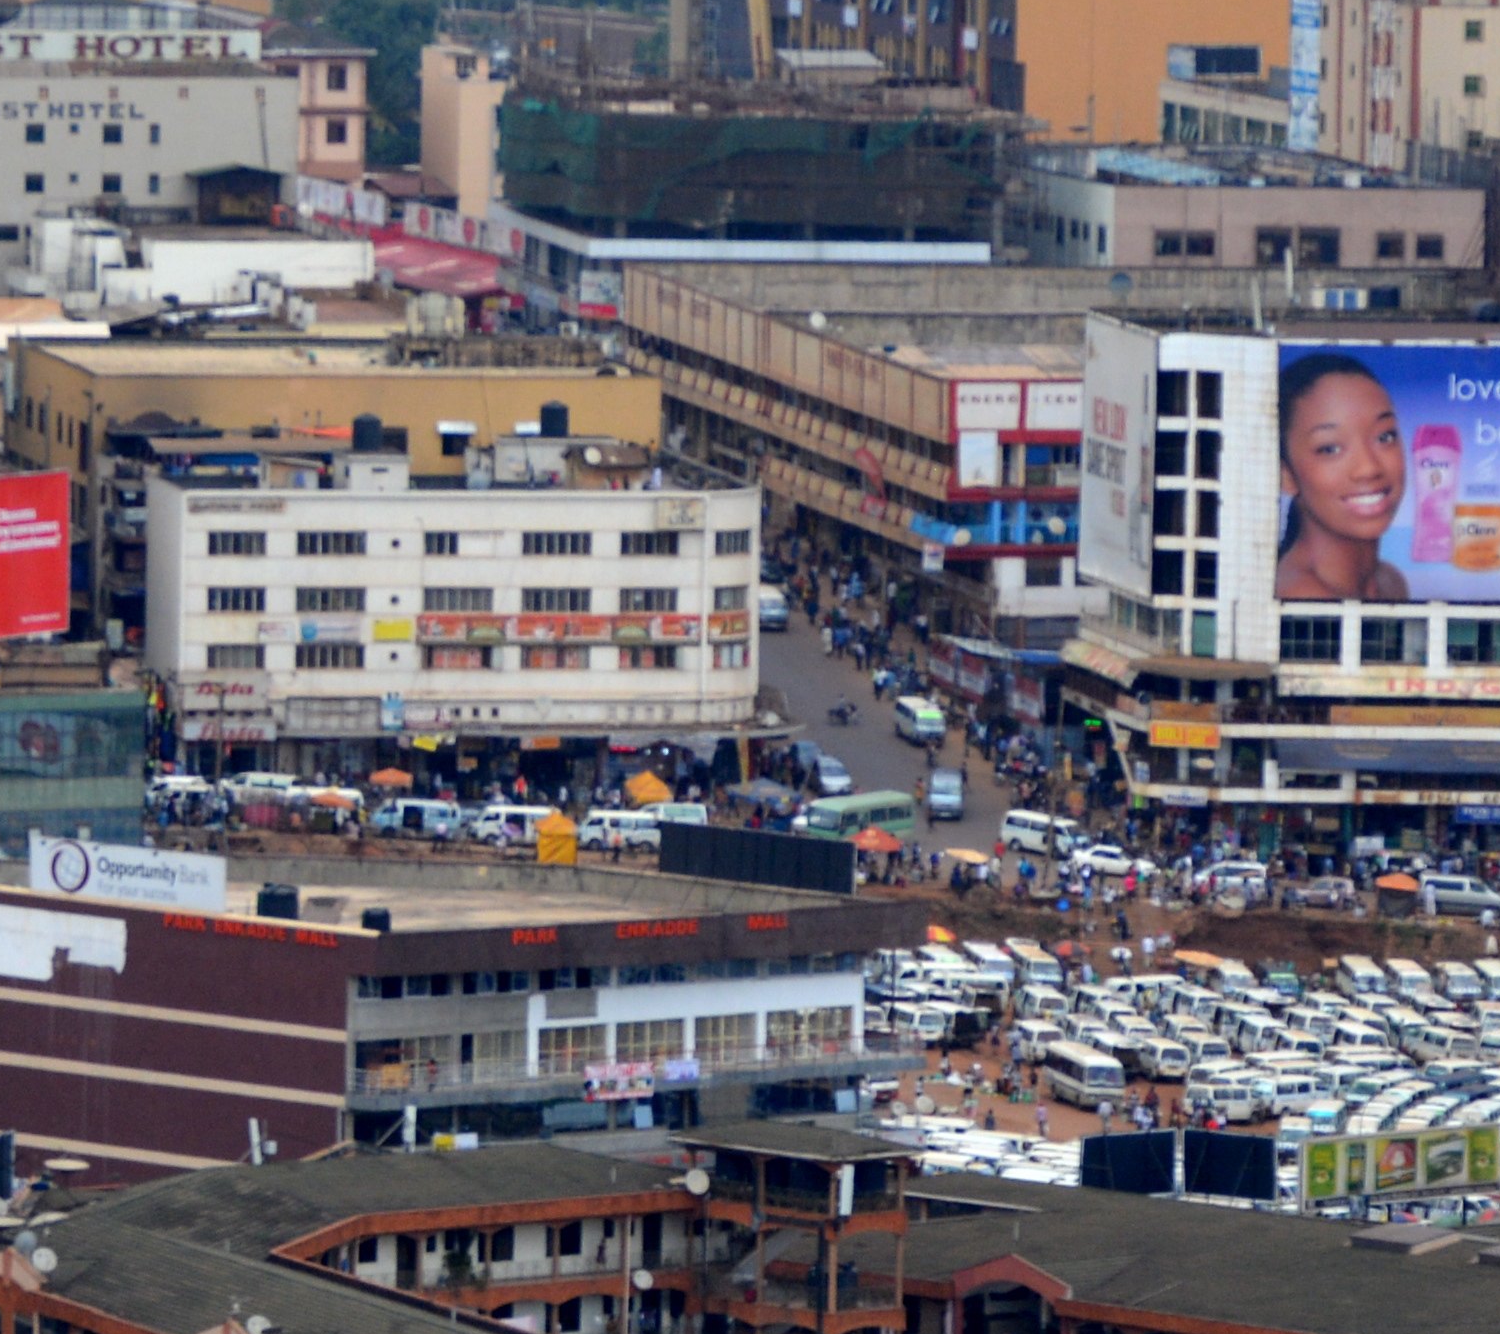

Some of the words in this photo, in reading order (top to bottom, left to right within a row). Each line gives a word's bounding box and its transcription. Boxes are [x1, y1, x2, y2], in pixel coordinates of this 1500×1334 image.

[75, 33, 249, 60] HOTEL
[48, 103, 145, 121] HOTEL
[97, 856, 178, 886] Opportunity
[163, 913, 206, 931] PARK
[297, 929, 339, 948] MALL
[512, 925, 557, 945] PARK
[616, 918, 698, 940] ENKADDE
[748, 913, 789, 931] MALL
